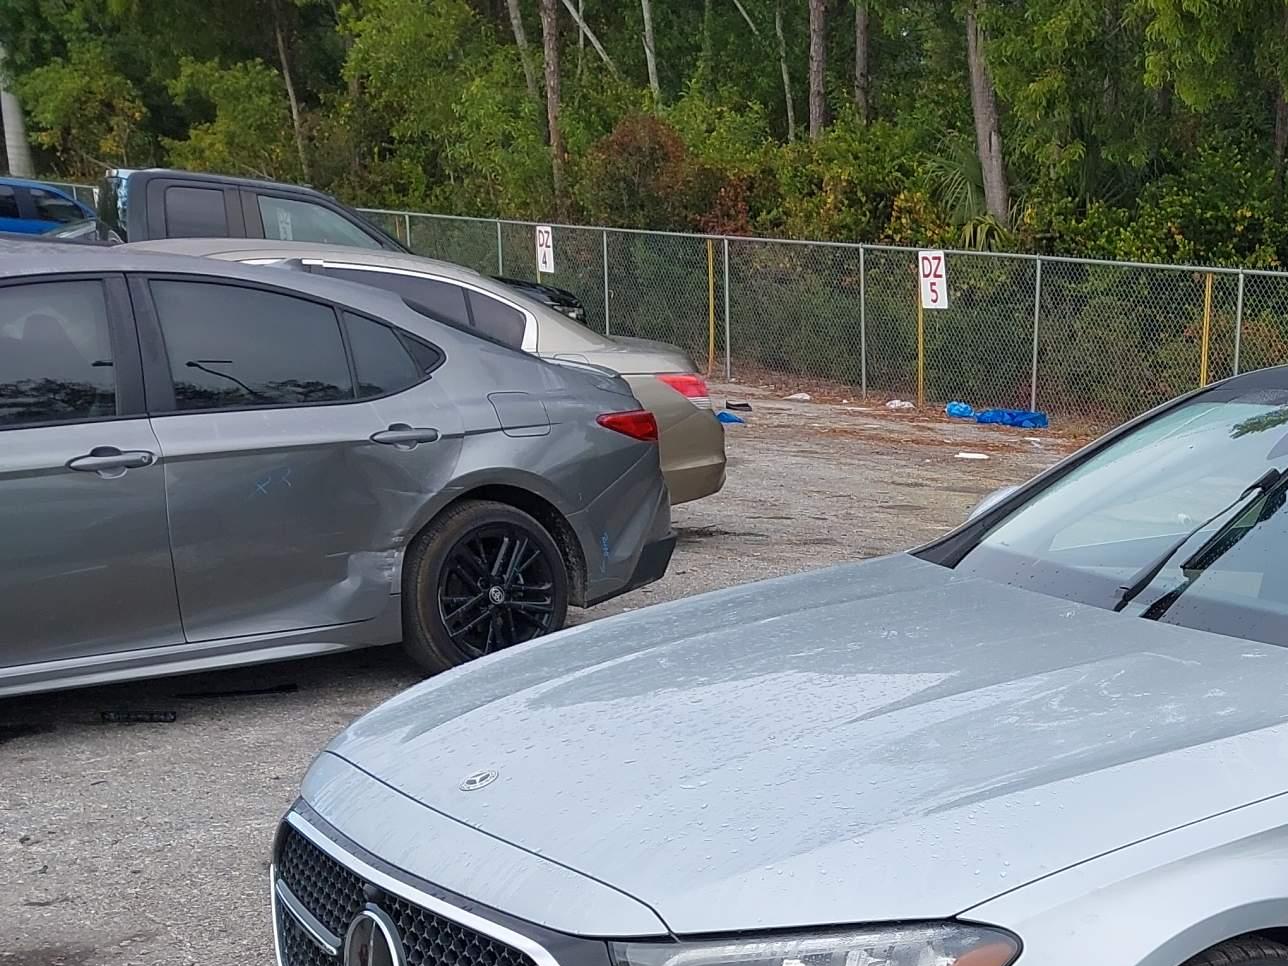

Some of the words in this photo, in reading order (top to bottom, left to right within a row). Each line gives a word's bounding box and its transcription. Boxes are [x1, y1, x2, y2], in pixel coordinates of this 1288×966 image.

[538, 230, 551, 248] DZ
[921, 256, 943, 278] DZ
[930, 282, 938, 303] 5
